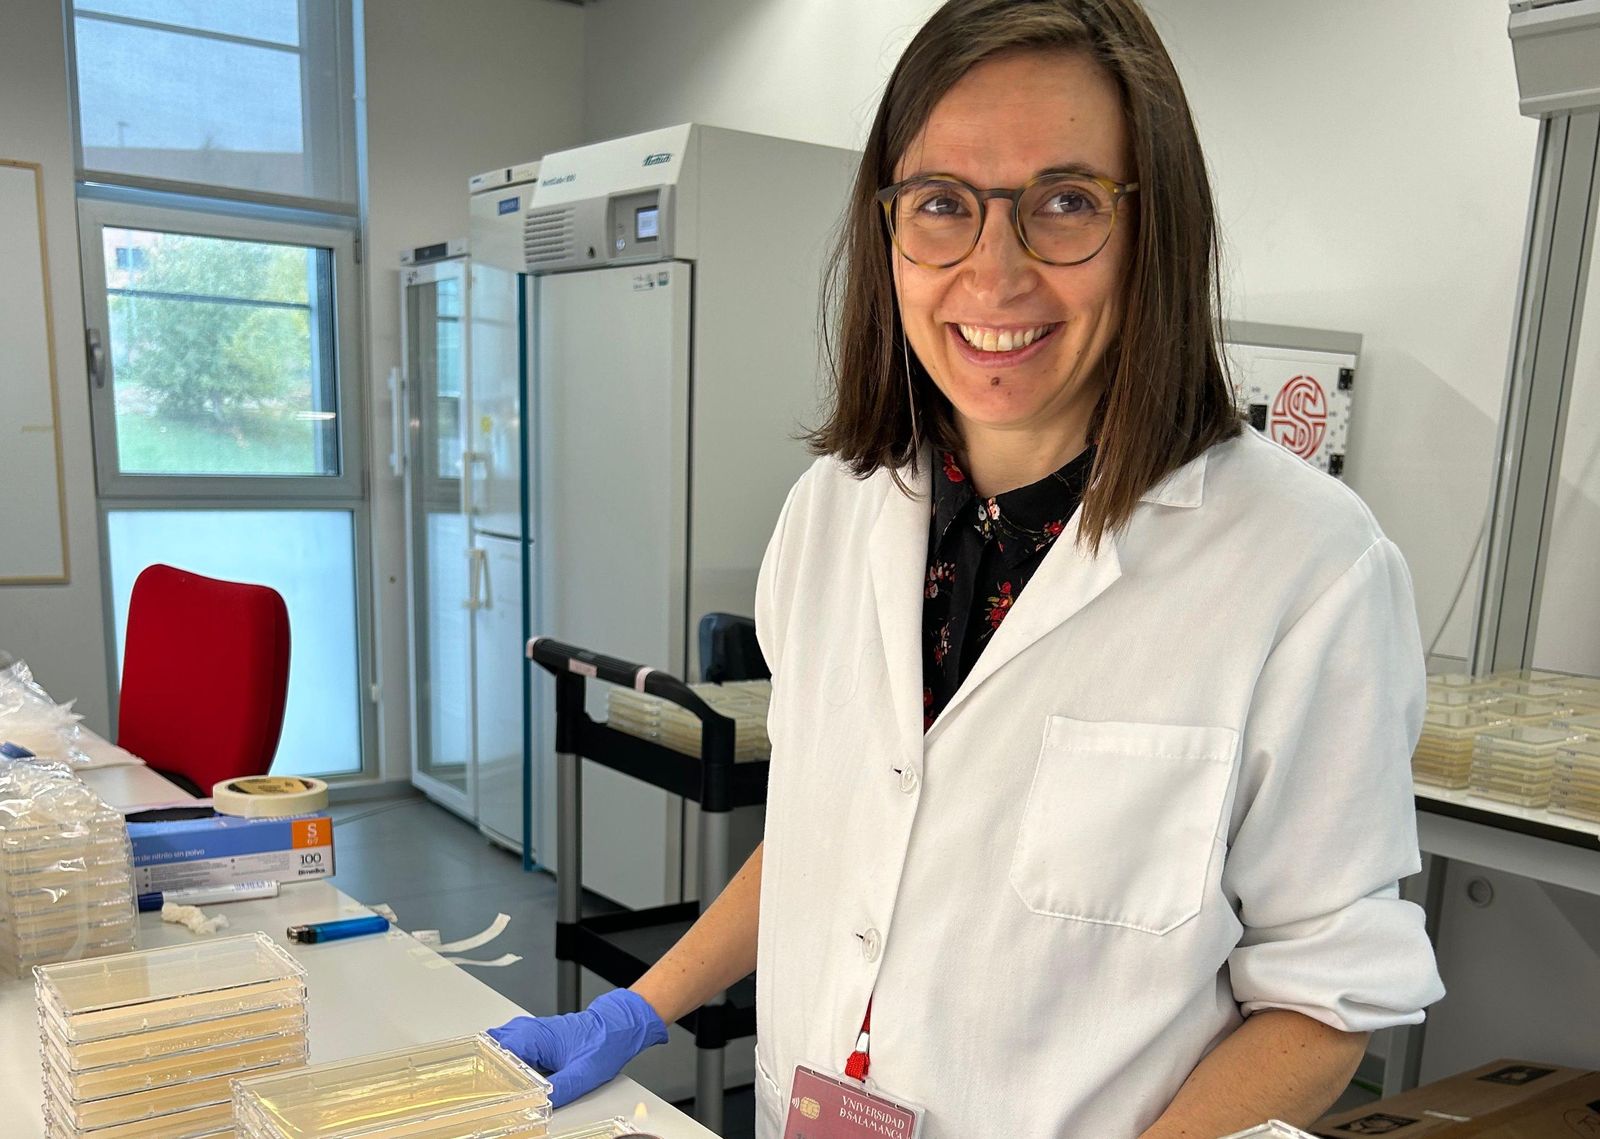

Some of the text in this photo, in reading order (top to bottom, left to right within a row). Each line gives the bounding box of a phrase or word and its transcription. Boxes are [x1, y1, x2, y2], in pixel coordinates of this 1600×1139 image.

[307, 823, 318, 838] S
[185, 848, 205, 858] polvo
[300, 852, 322, 864] 100
